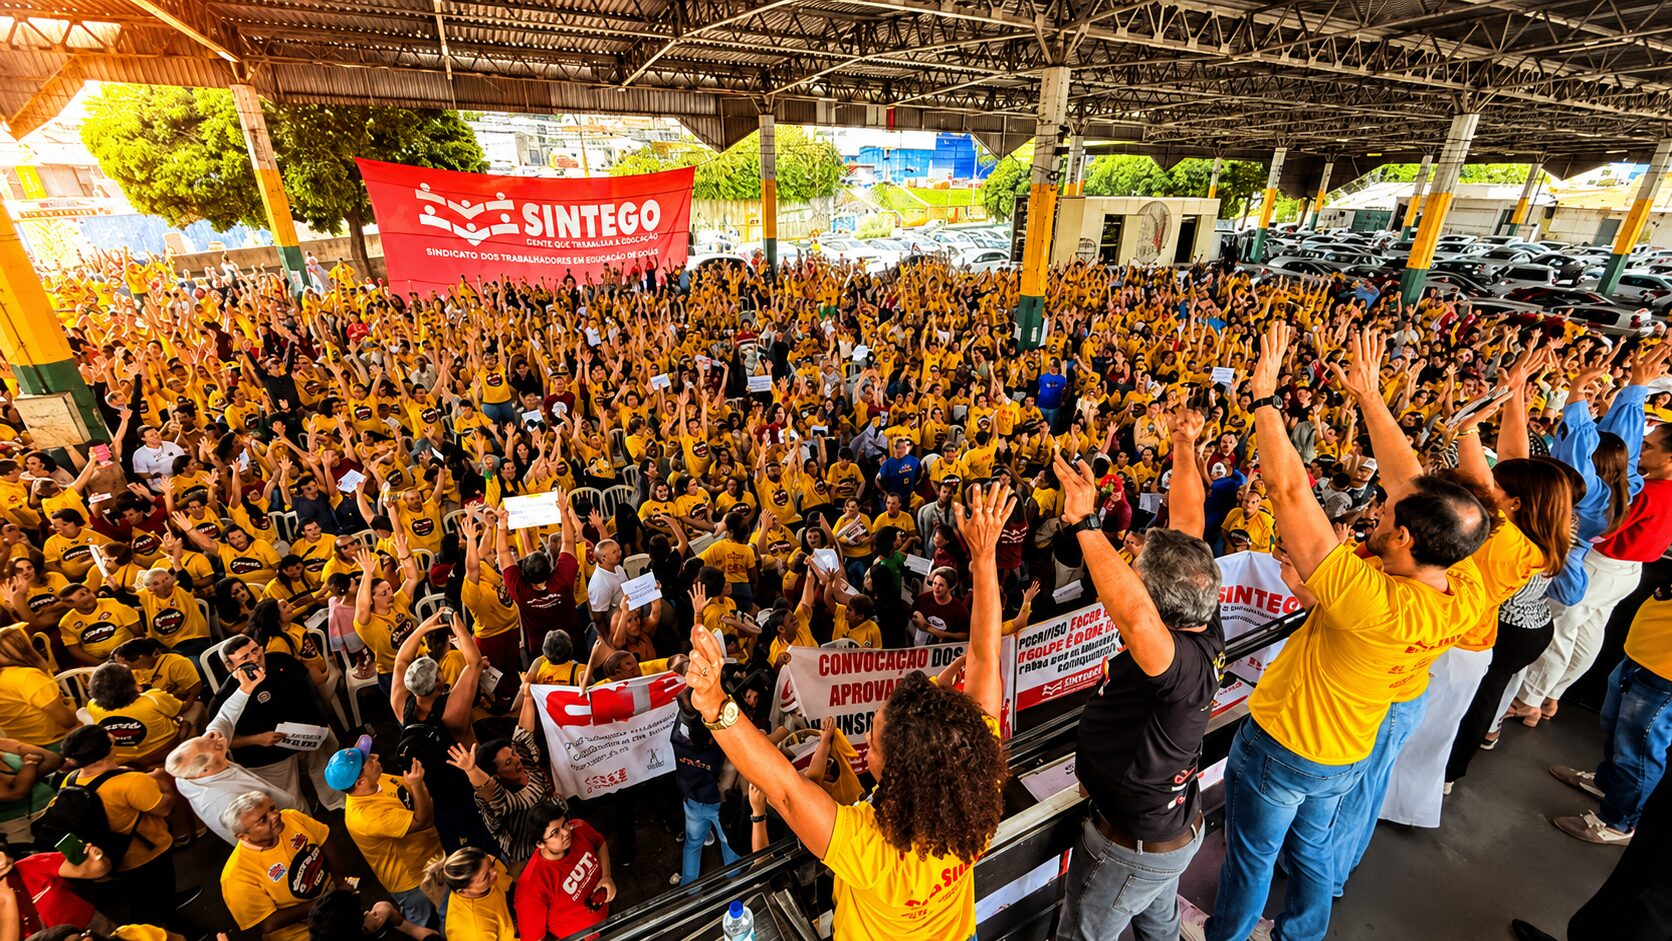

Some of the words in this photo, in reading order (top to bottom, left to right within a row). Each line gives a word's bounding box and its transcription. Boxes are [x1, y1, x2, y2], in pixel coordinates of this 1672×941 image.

[522, 199, 660, 238] SINTEGO
[426, 247, 478, 259] SINDICATO
[480, 251, 500, 261] DOS
[500, 253, 571, 265] TRABALHADORES
[1218, 584, 1302, 615] SINTEG
[818, 648, 929, 676] CONVOCAÇÃO
[931, 646, 964, 667] DOS
[562, 851, 593, 895] CUT
